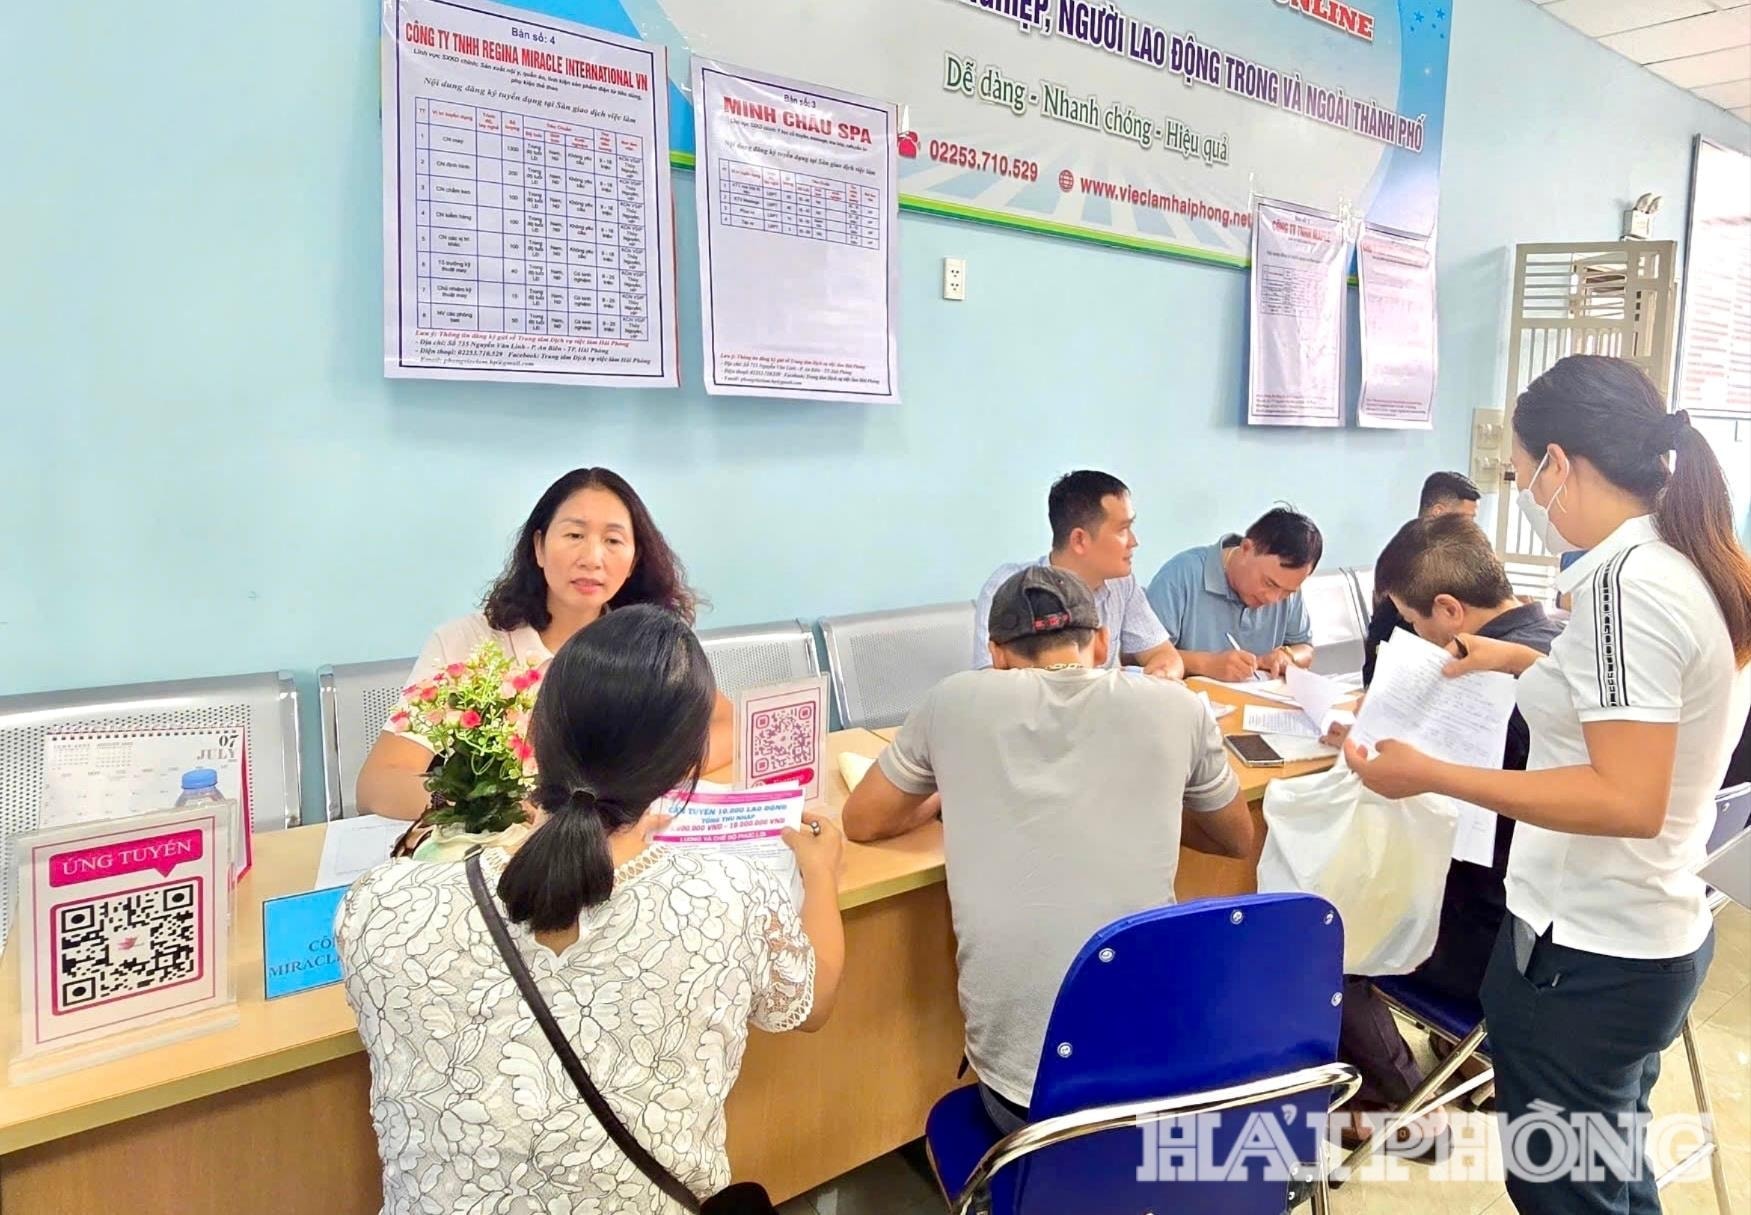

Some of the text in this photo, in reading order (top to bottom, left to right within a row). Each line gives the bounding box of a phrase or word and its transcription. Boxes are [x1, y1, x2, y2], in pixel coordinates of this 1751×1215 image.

[511, 26, 556, 45] Bàn số: 4
[1289, 0, 1373, 39] LINE
[405, 20, 648, 91] CÔNG TY TNHH REGINA MIRACLE INTERNATIONAL VN
[1058, 0, 1123, 51] NGƯỜI
[1130, 22, 1166, 65] LAO
[1170, 35, 1220, 84] ĐỘNG
[1225, 56, 1279, 104] TRONG
[1283, 73, 1301, 112] VÀ
[1306, 84, 1349, 129] NGOÀI
[1353, 102, 1396, 142] THÀNH
[1399, 114, 1426, 151] PHỐ
[424, 77, 439, 87] Nội
[440, 80, 463, 92] dung
[464, 84, 486, 96] đăng
[487, 88, 498, 98] ký
[498, 91, 521, 102] tuyển
[522, 95, 543, 106] dụng
[556, 101, 571, 111] Sàn
[572, 104, 589, 114] giao
[590, 107, 606, 118] dịch
[947, 57, 974, 94] Dễ
[981, 68, 1026, 112] dàng
[1043, 84, 1100, 127] Nhanh
[1105, 105, 1152, 147] chóng
[1166, 121, 1199, 157] Hiệu
[1203, 135, 1228, 163] quả
[723, 96, 777, 124] MINH
[837, 122, 873, 145] SPA
[929, 139, 1039, 182] 02253.710.529
[197, 748, 235, 760] JULY
[219, 735, 239, 748] 07
[62, 854, 113, 876] ỨNG
